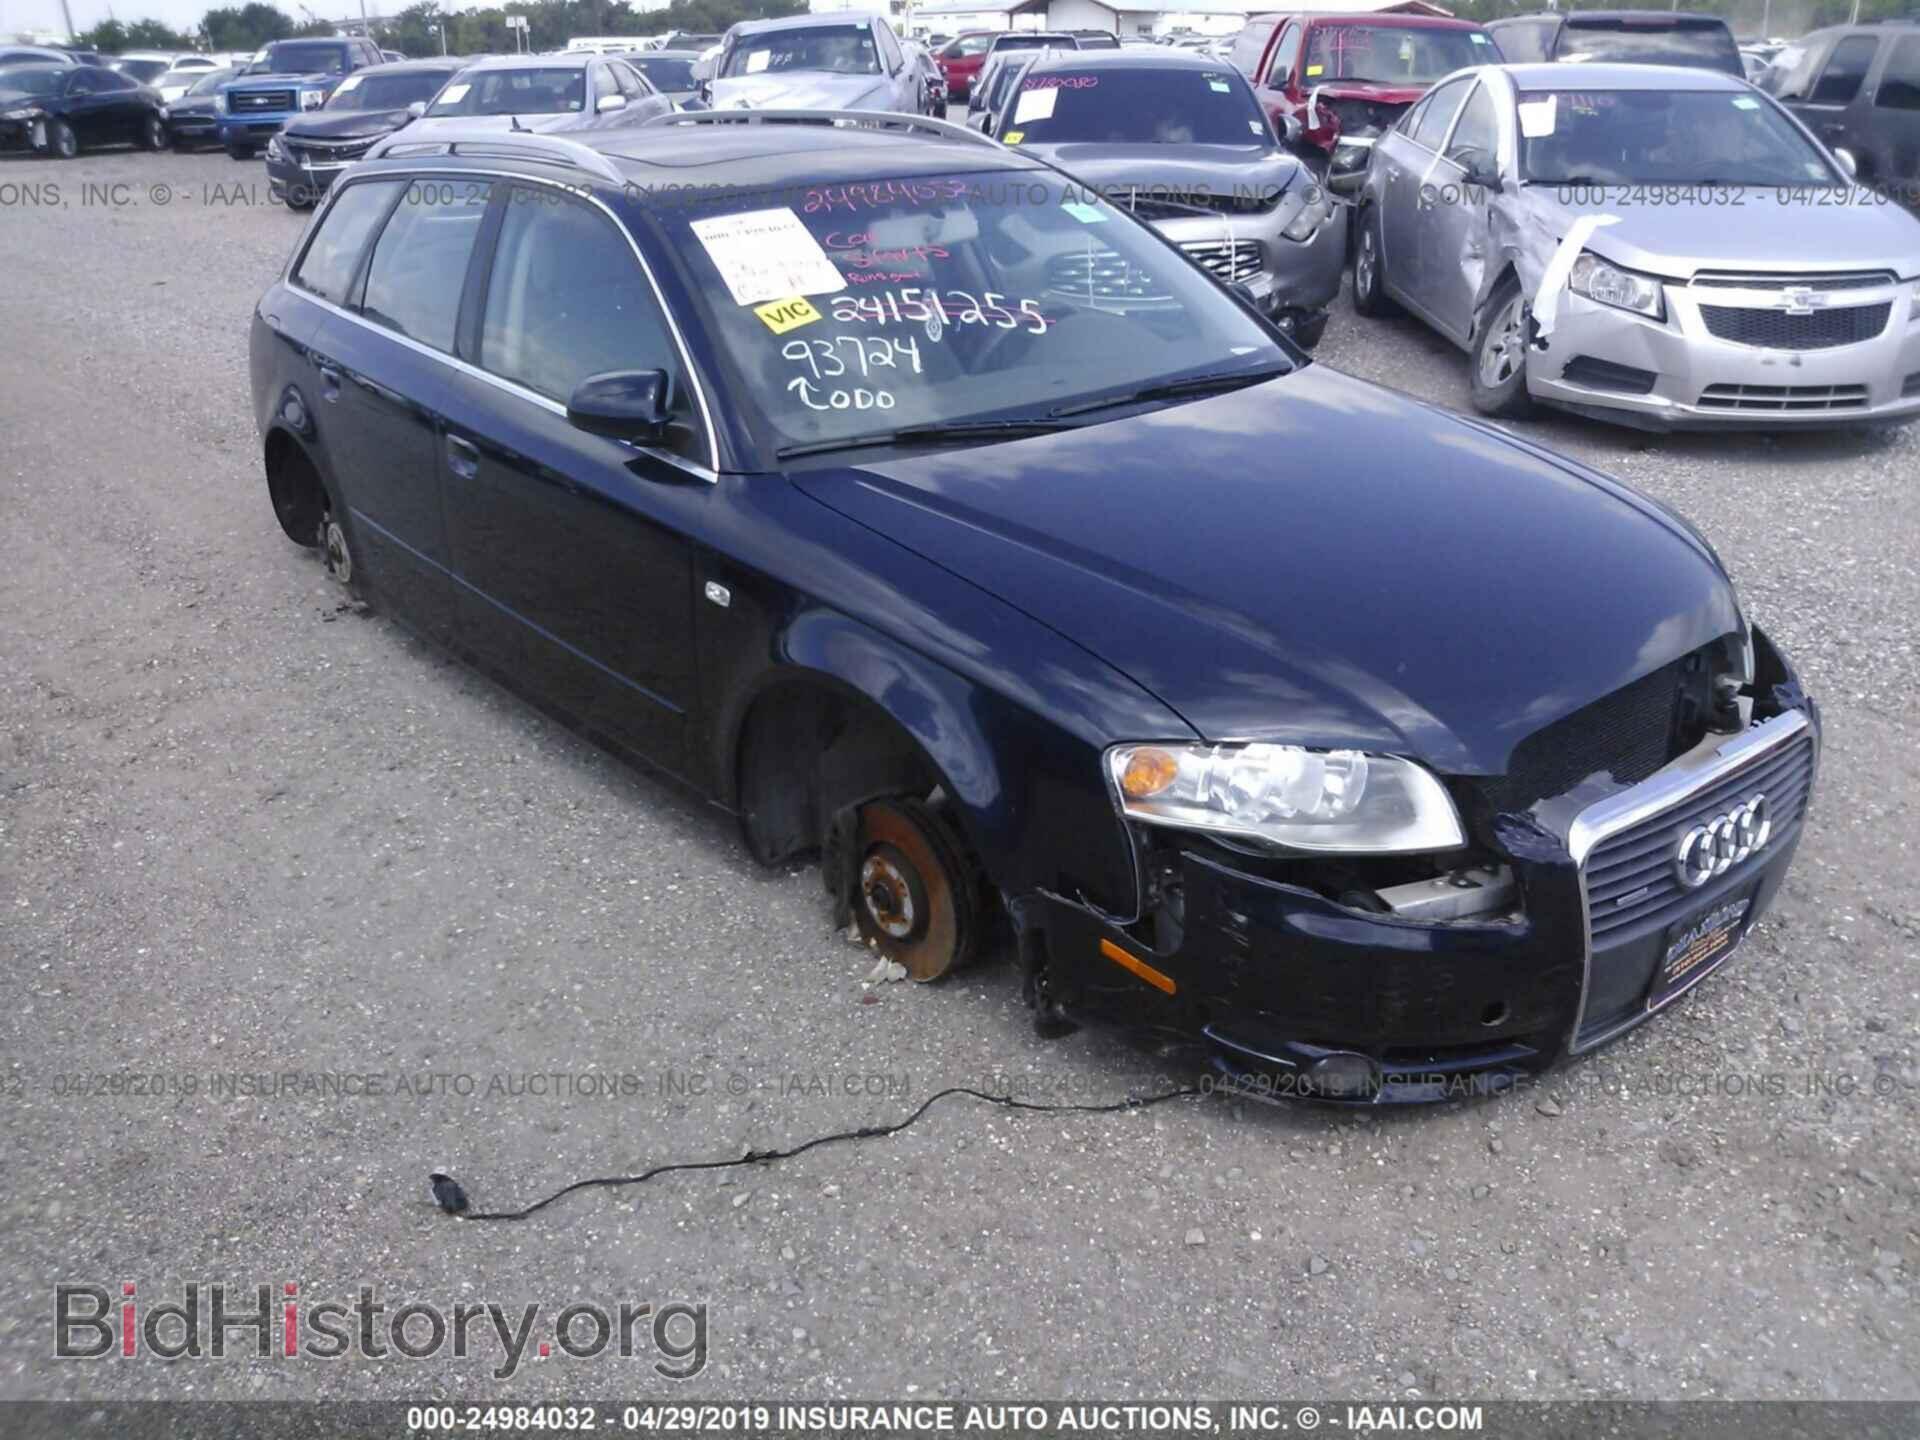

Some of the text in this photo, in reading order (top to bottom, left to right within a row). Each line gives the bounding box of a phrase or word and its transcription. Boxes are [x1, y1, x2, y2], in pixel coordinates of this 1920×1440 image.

[764, 301, 813, 325] VIC
[831, 289, 1049, 335] 24151255
[781, 335, 923, 379] 93724
